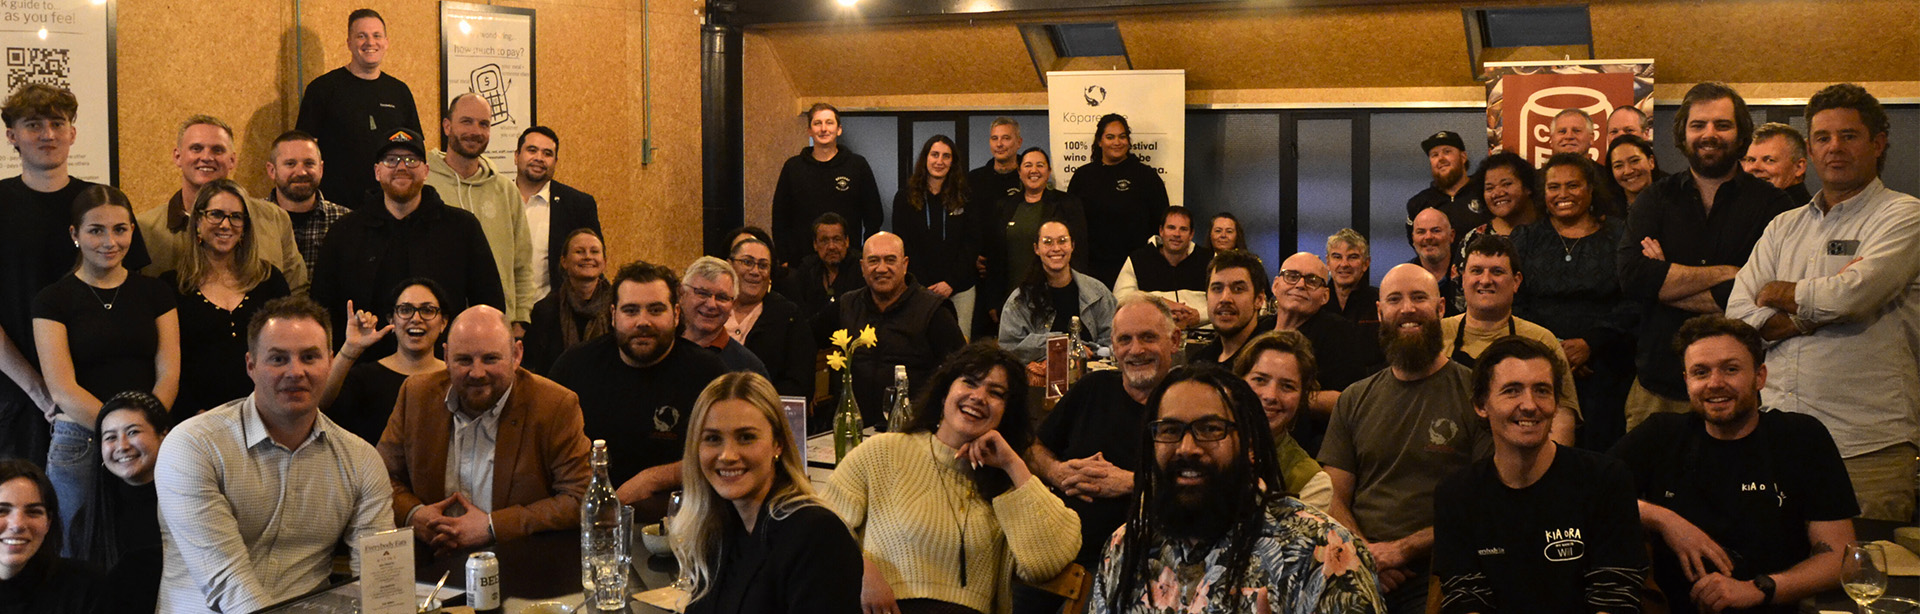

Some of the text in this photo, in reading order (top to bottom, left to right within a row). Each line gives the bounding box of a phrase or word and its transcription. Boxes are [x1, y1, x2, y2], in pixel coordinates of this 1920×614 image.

[10, 0, 40, 11] guide
[4, 12, 76, 25] as you feel
[506, 47, 525, 58] pay?
[1064, 141, 1088, 151] 100%
[1063, 152, 1152, 162] wine be
[1742, 482, 1757, 492] KIA
[1545, 528, 1563, 543] KIA
